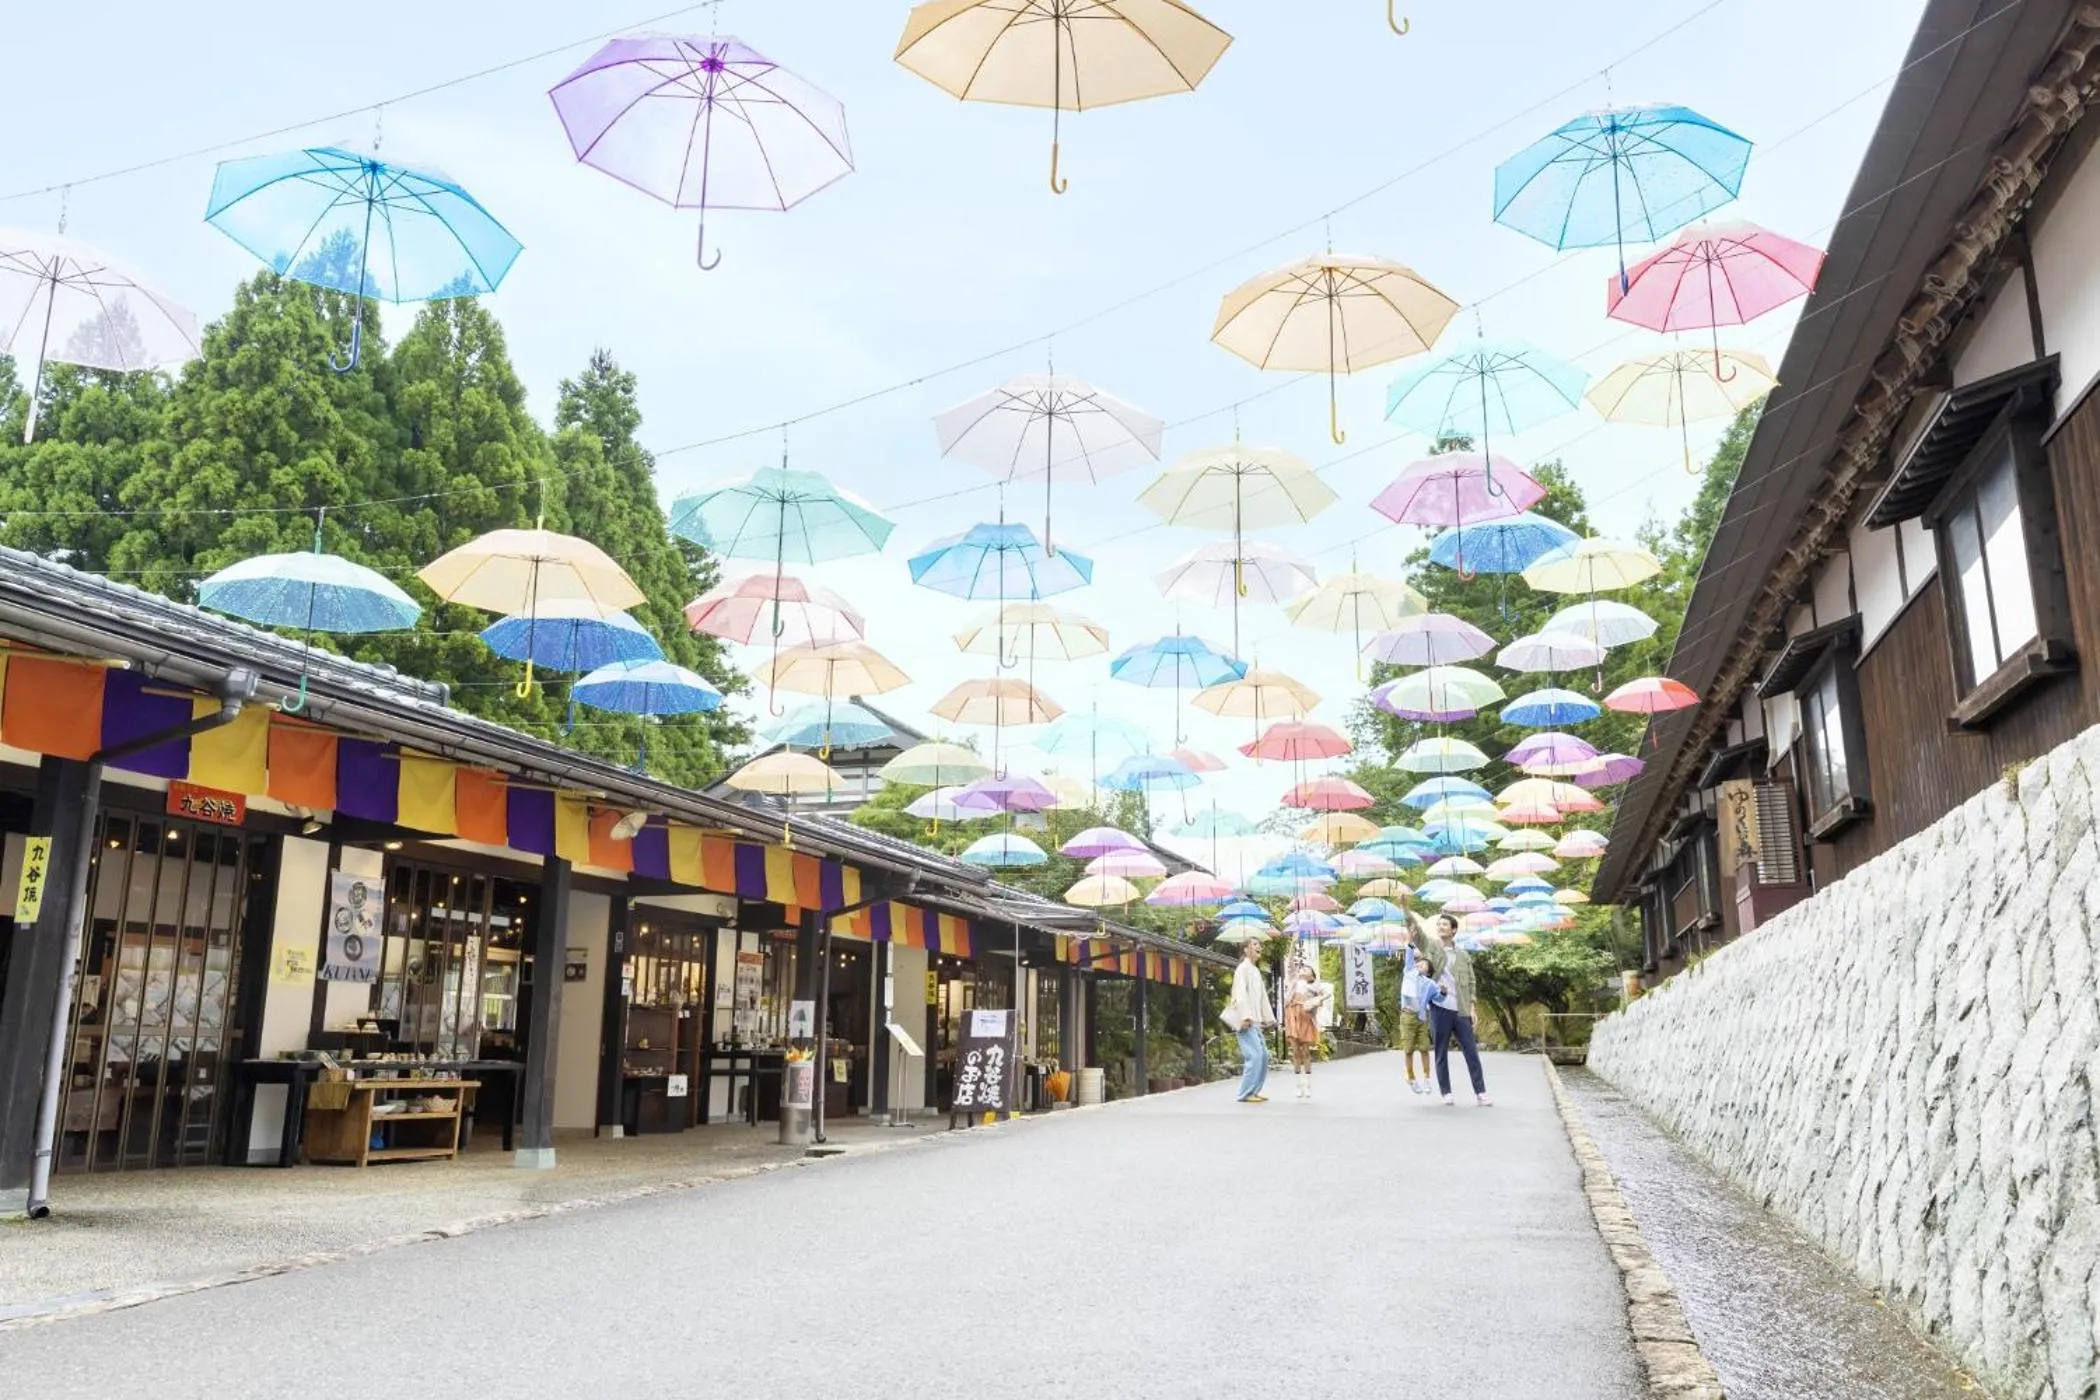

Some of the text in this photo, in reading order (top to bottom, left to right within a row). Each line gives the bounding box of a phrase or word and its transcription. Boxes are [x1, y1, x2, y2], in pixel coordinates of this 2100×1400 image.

[180, 794, 236, 822] 九谷焼
[23, 845, 44, 902] 九谷焼
[953, 1049, 982, 1106] のお店
[977, 1044, 1005, 1108] 九谷焼
